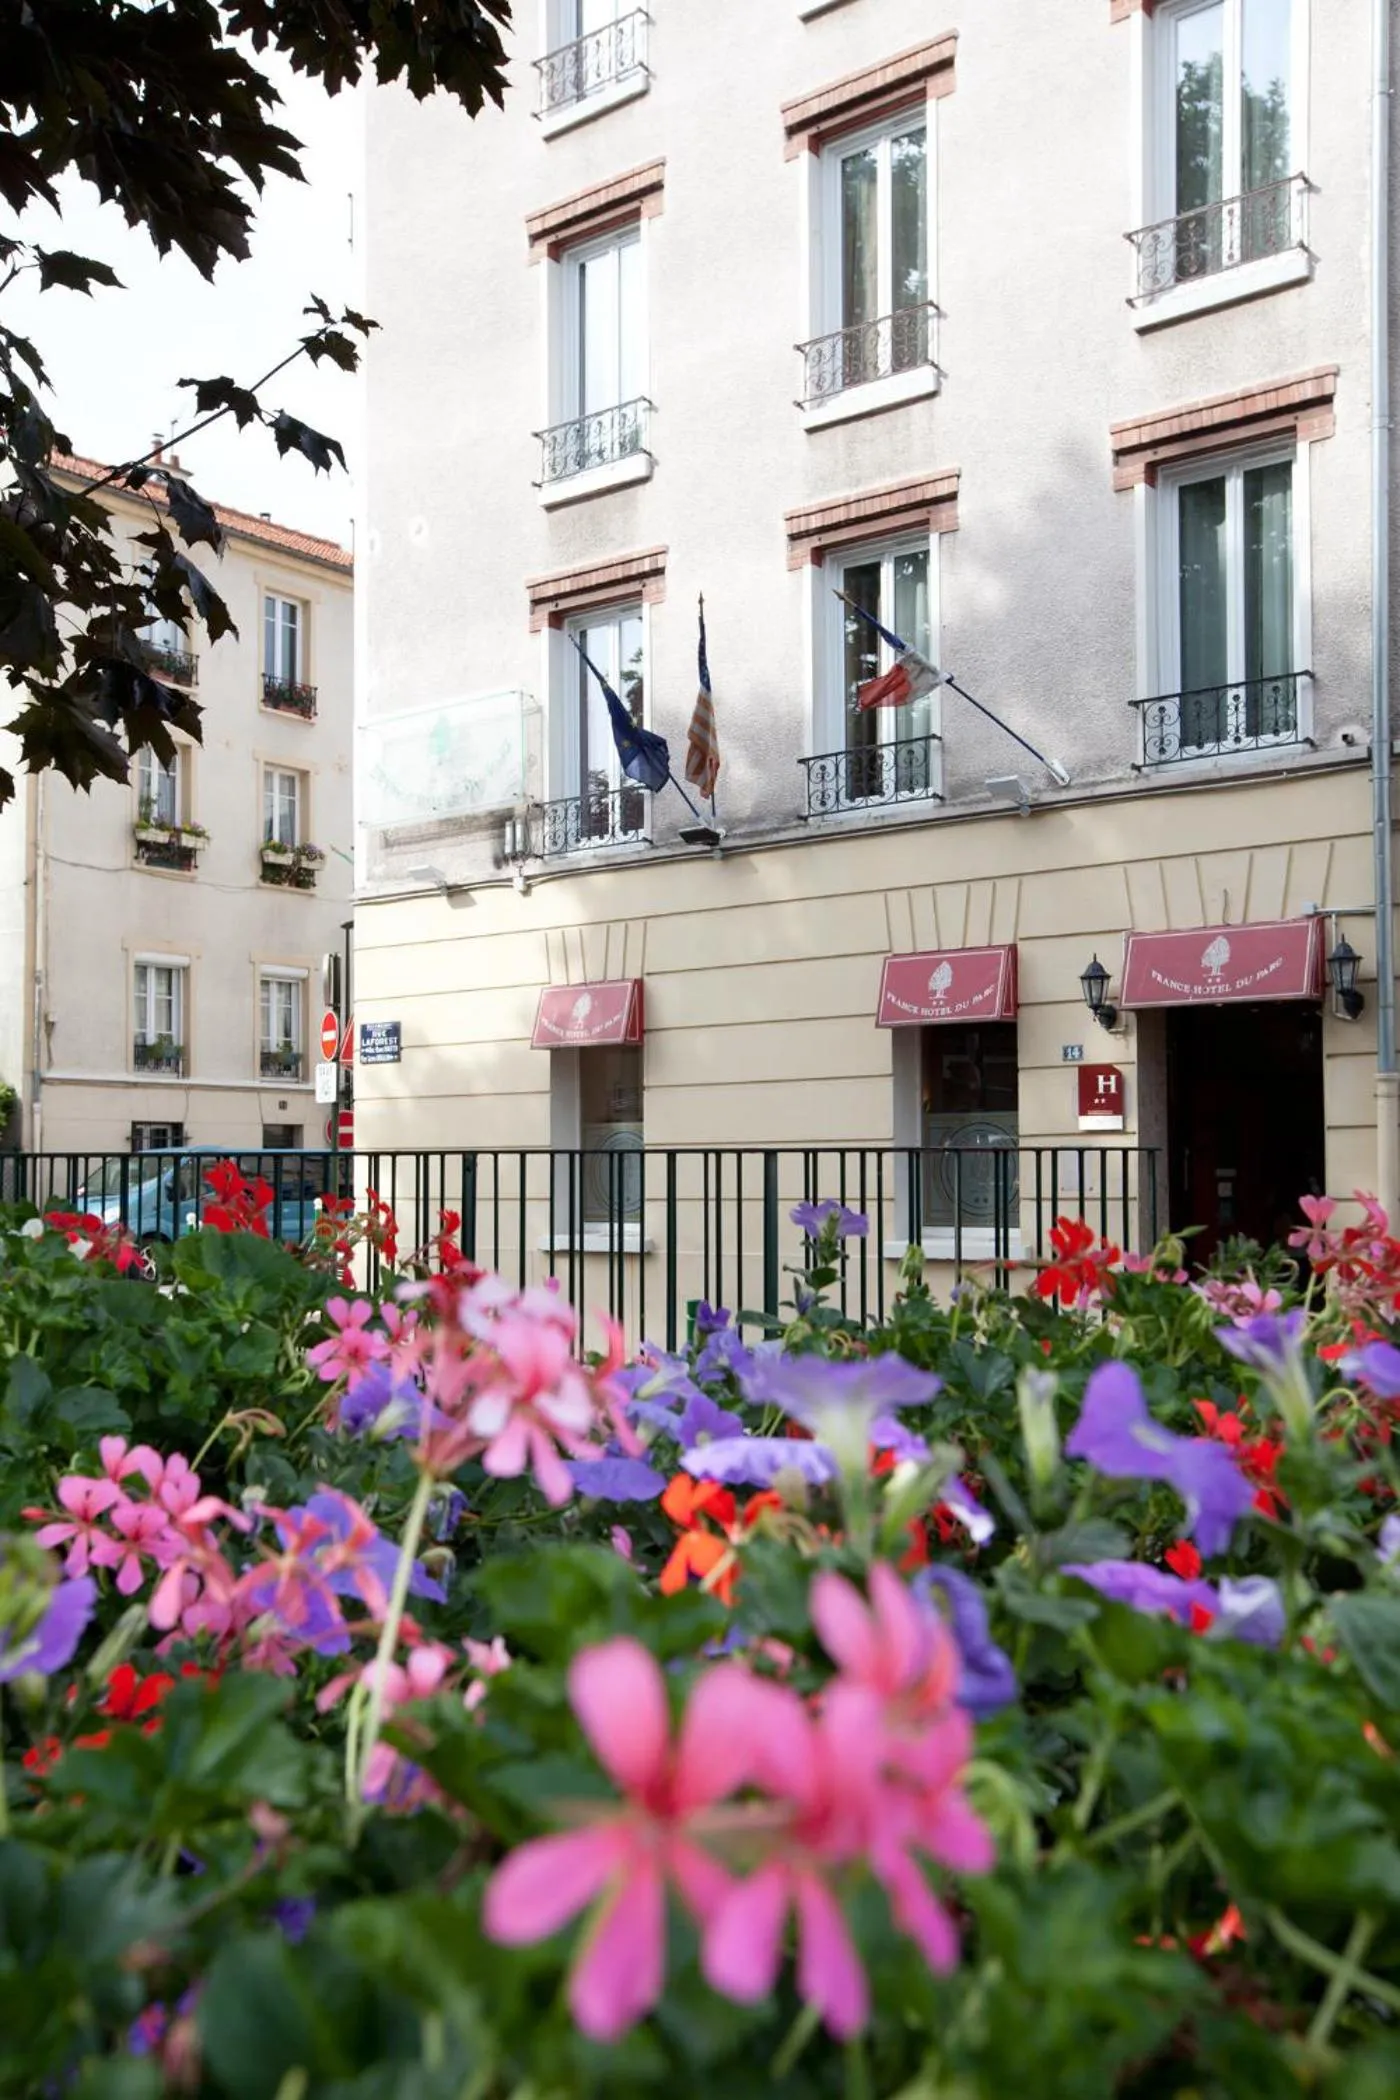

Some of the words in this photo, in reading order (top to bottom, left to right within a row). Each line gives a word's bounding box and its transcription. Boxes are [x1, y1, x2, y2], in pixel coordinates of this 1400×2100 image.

[1151, 969, 1191, 993] FRANCE
[1193, 984, 1231, 995] HOTEL
[1236, 976, 1253, 989] DU
[920, 1007, 952, 1017] HOTEL
[954, 1001, 970, 1012] DU
[1097, 1074, 1118, 1094] H
